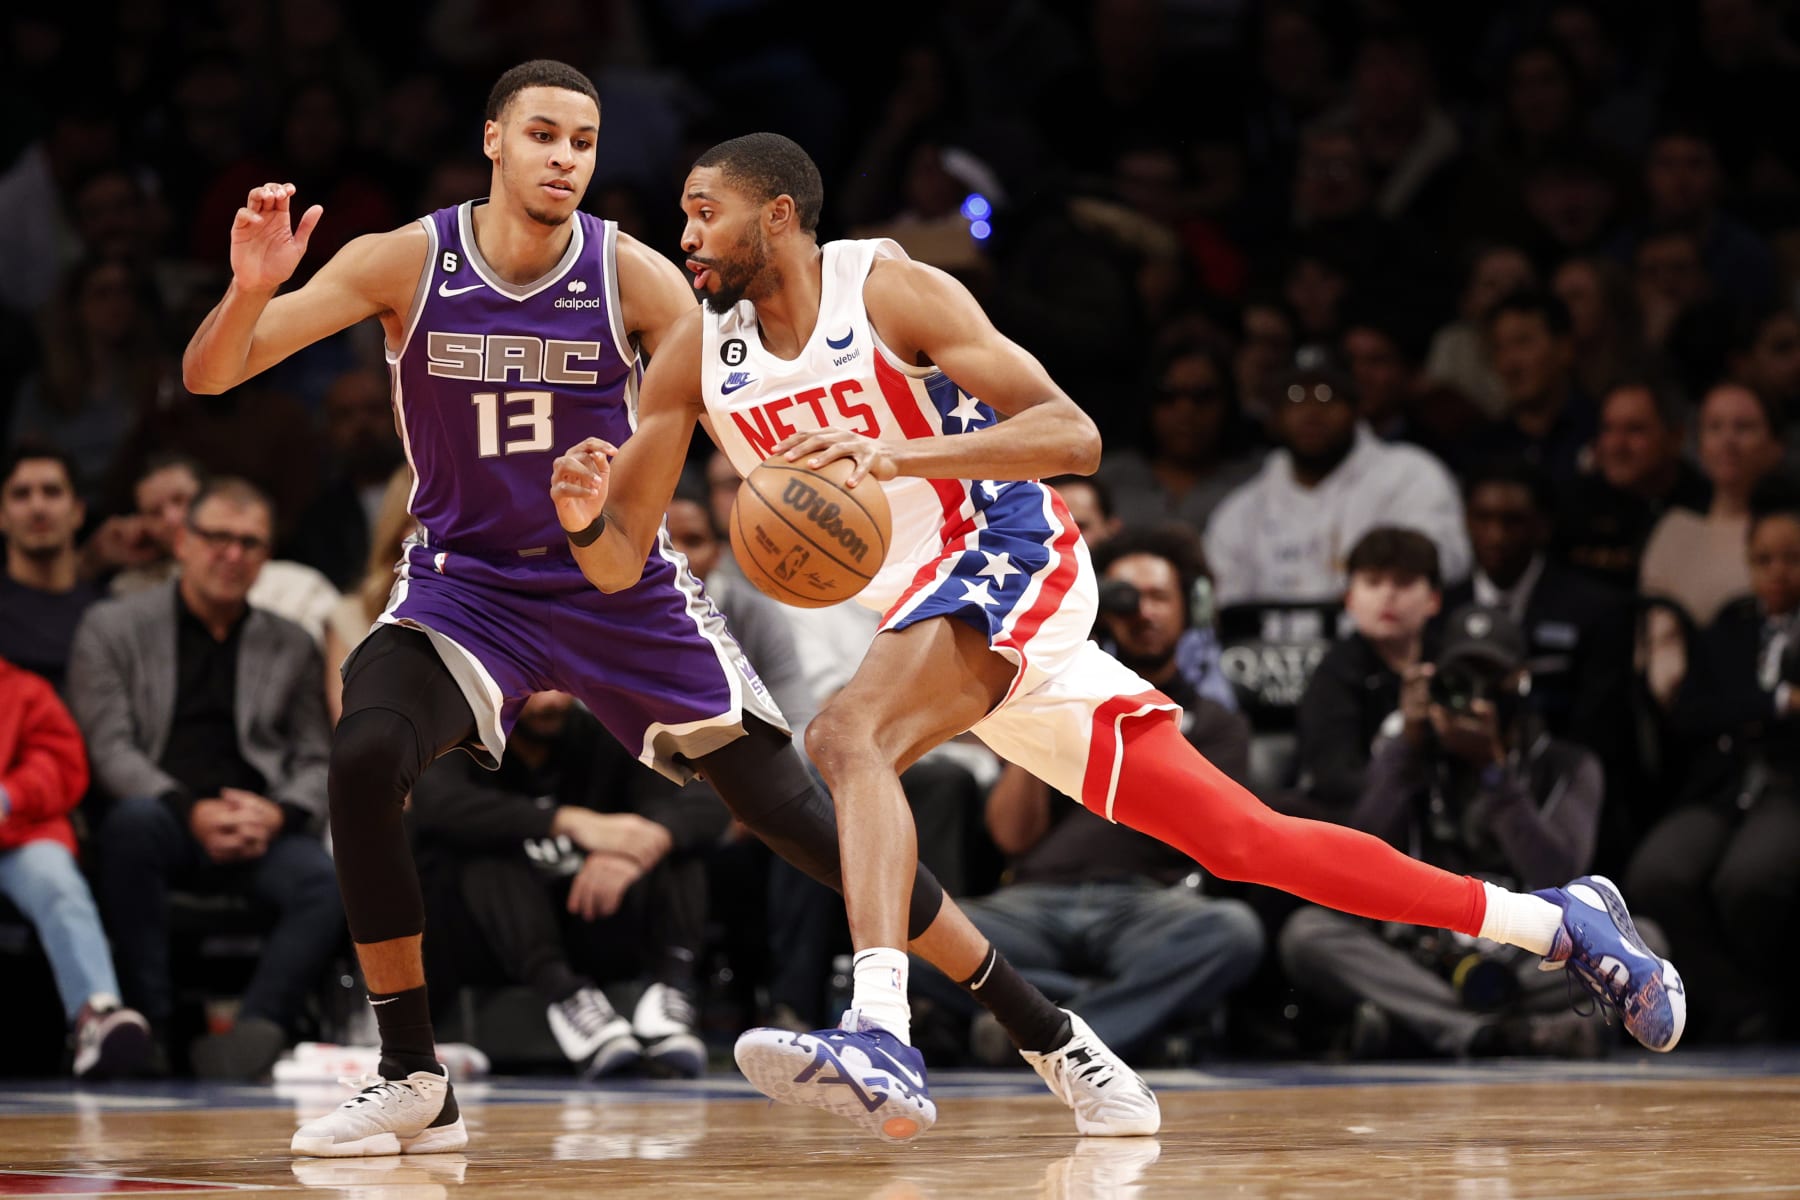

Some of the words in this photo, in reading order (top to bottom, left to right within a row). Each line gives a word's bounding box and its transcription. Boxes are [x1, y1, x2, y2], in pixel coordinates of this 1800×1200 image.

[442, 251, 457, 272] 6
[554, 297, 600, 311] dialpad
[427, 331, 600, 385] SAC
[726, 342, 743, 364] 6
[833, 349, 860, 367] Webull
[471, 391, 554, 458] 13
[730, 378, 881, 461] NETS
[782, 476, 869, 563] Wilson
